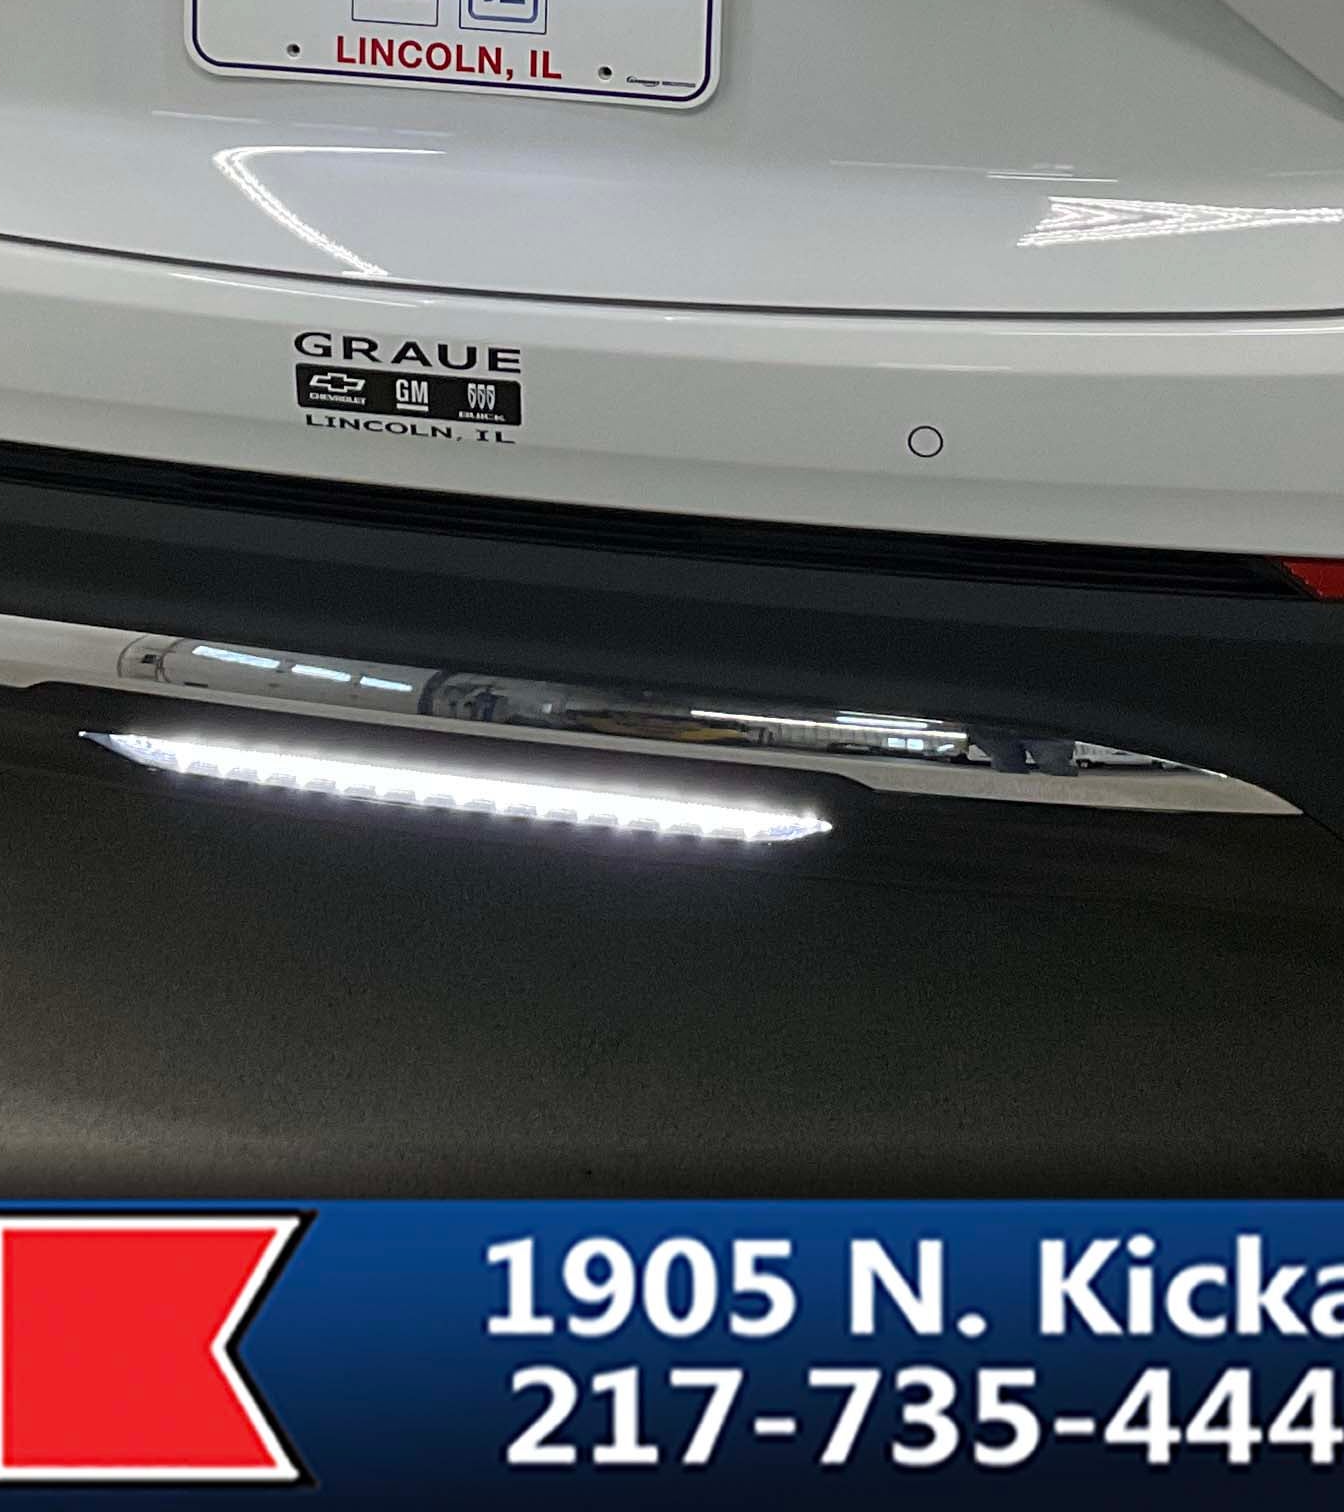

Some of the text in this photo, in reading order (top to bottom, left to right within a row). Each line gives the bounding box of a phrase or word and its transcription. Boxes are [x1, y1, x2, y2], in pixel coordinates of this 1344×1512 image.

[336, 35, 562, 81] LINCOLN, IL
[294, 331, 521, 373] GRAUE
[308, 392, 367, 406] CHEVROLET
[395, 379, 429, 404] GM
[305, 414, 516, 445] LINCOLN, IL
